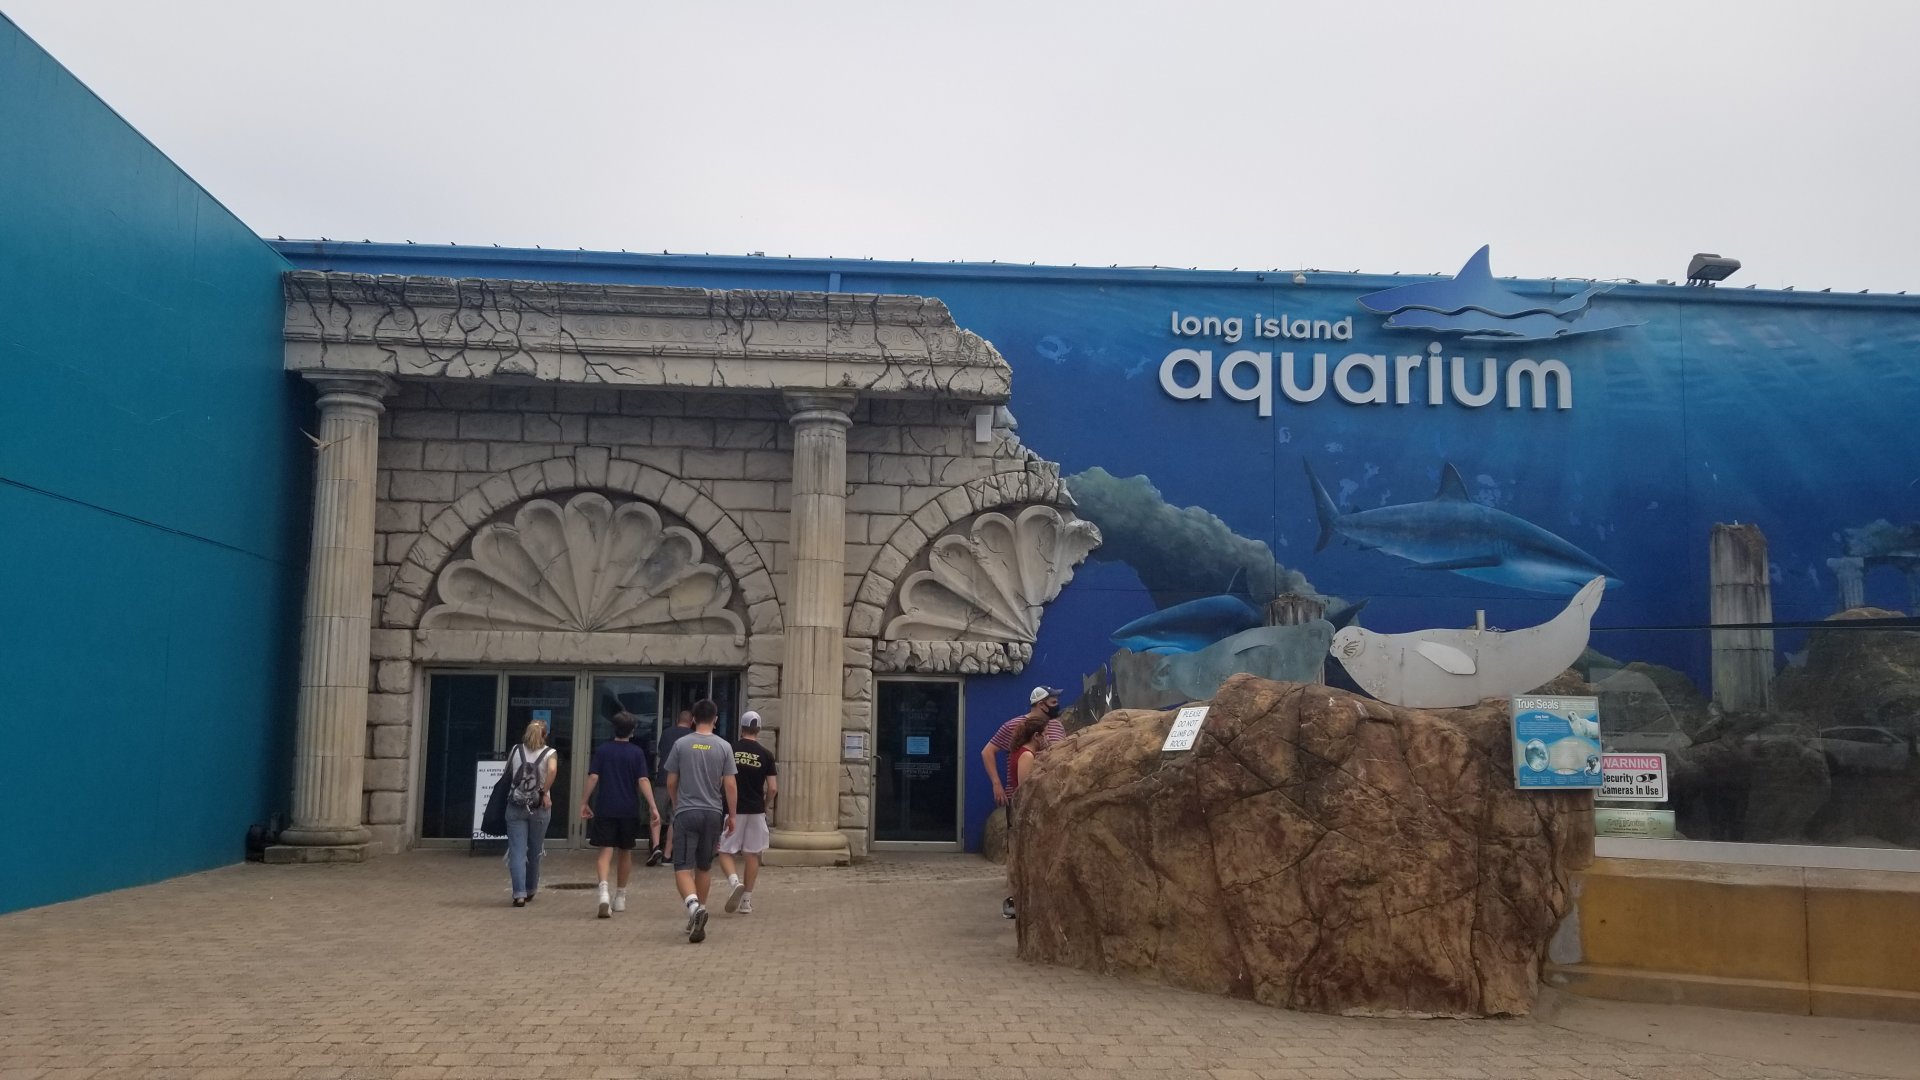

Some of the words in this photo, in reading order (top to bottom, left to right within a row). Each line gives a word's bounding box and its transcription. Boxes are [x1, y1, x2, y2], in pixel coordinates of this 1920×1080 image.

[1171, 311, 1243, 344] long
[1254, 313, 1353, 341] island
[1159, 341, 1573, 417] aquarium
[1516, 698, 1535, 709] True
[1536, 699, 1560, 710] Seals
[734, 751, 760, 760] STAY
[1602, 758, 1659, 769] WARNING
[1636, 785, 1644, 795] In
[1645, 785, 1659, 796] Use
